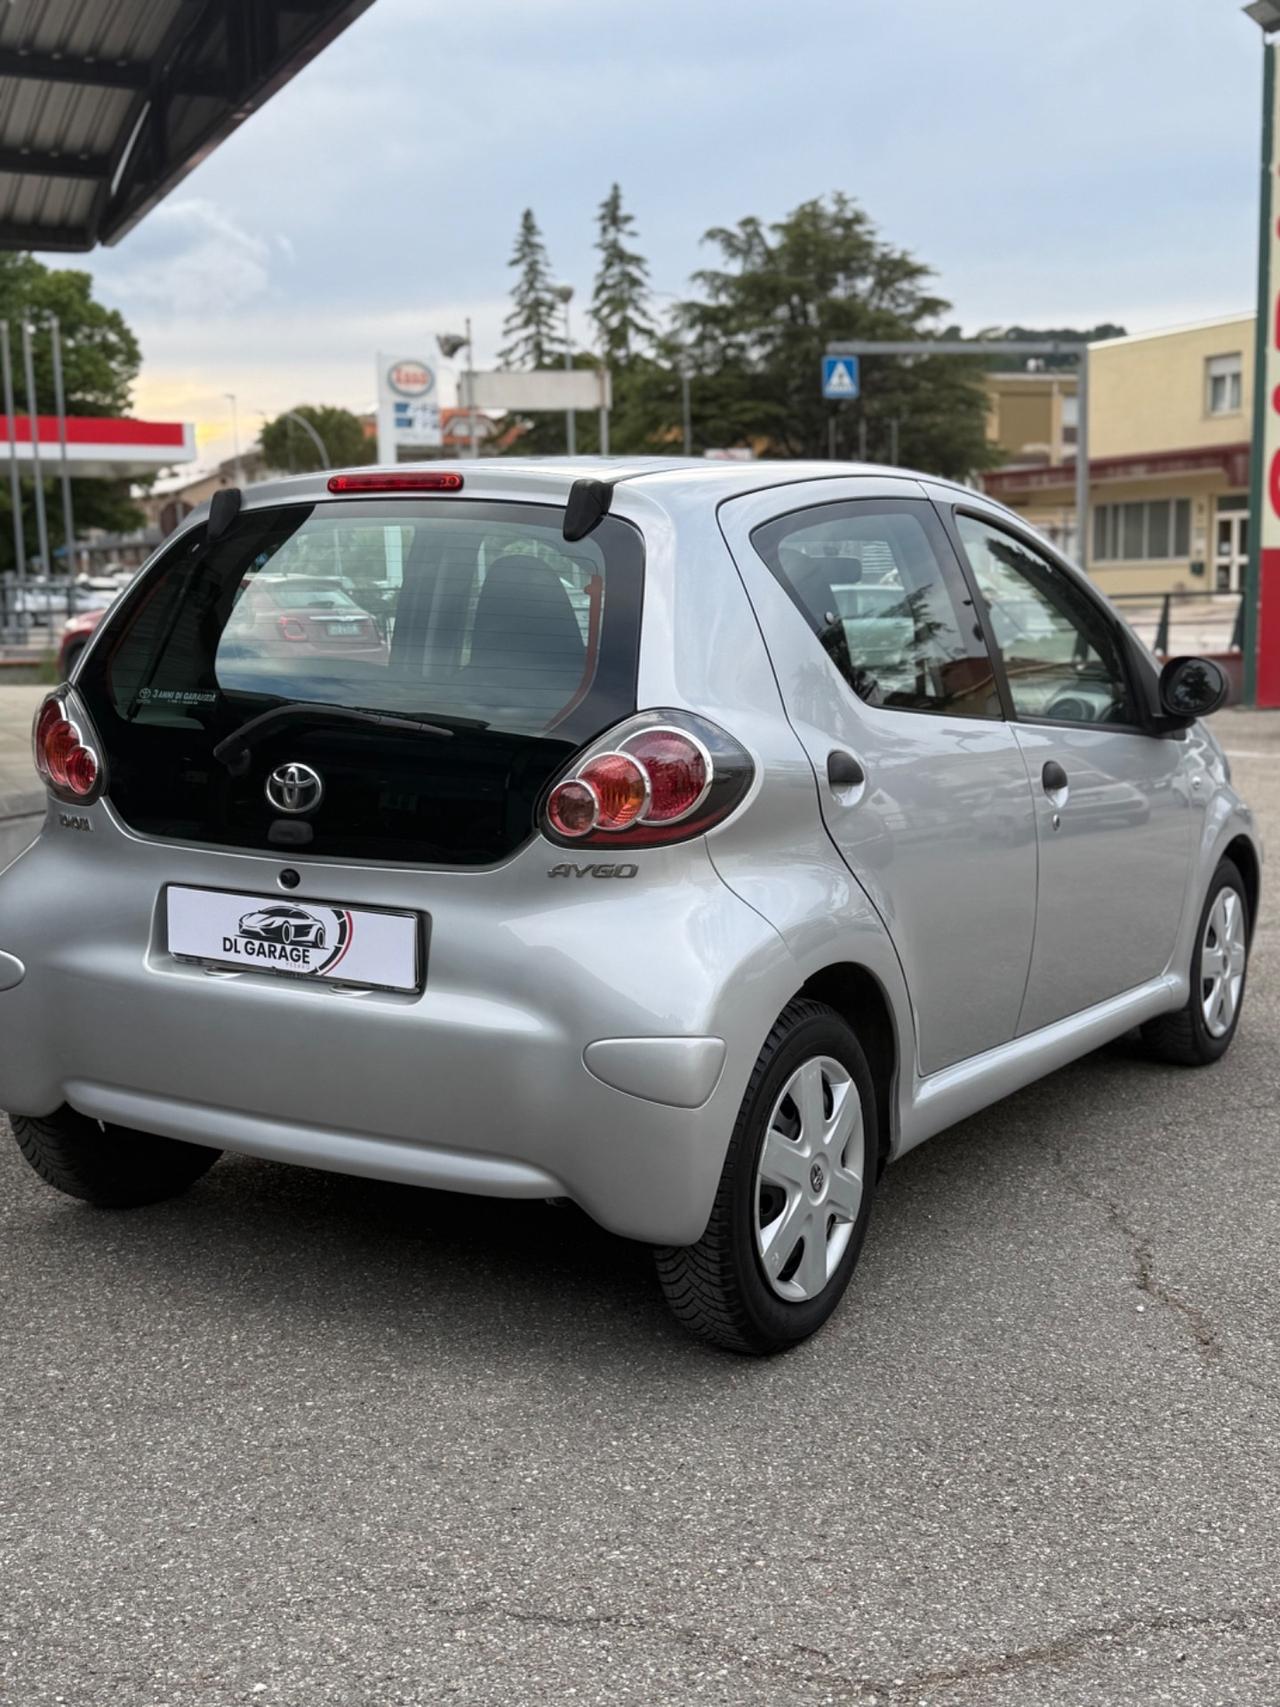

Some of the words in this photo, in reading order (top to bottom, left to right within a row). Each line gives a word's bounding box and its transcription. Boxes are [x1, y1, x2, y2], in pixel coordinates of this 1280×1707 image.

[547, 863, 639, 878] AYGO
[223, 937, 240, 954] DL
[244, 940, 310, 964] GARAGE
